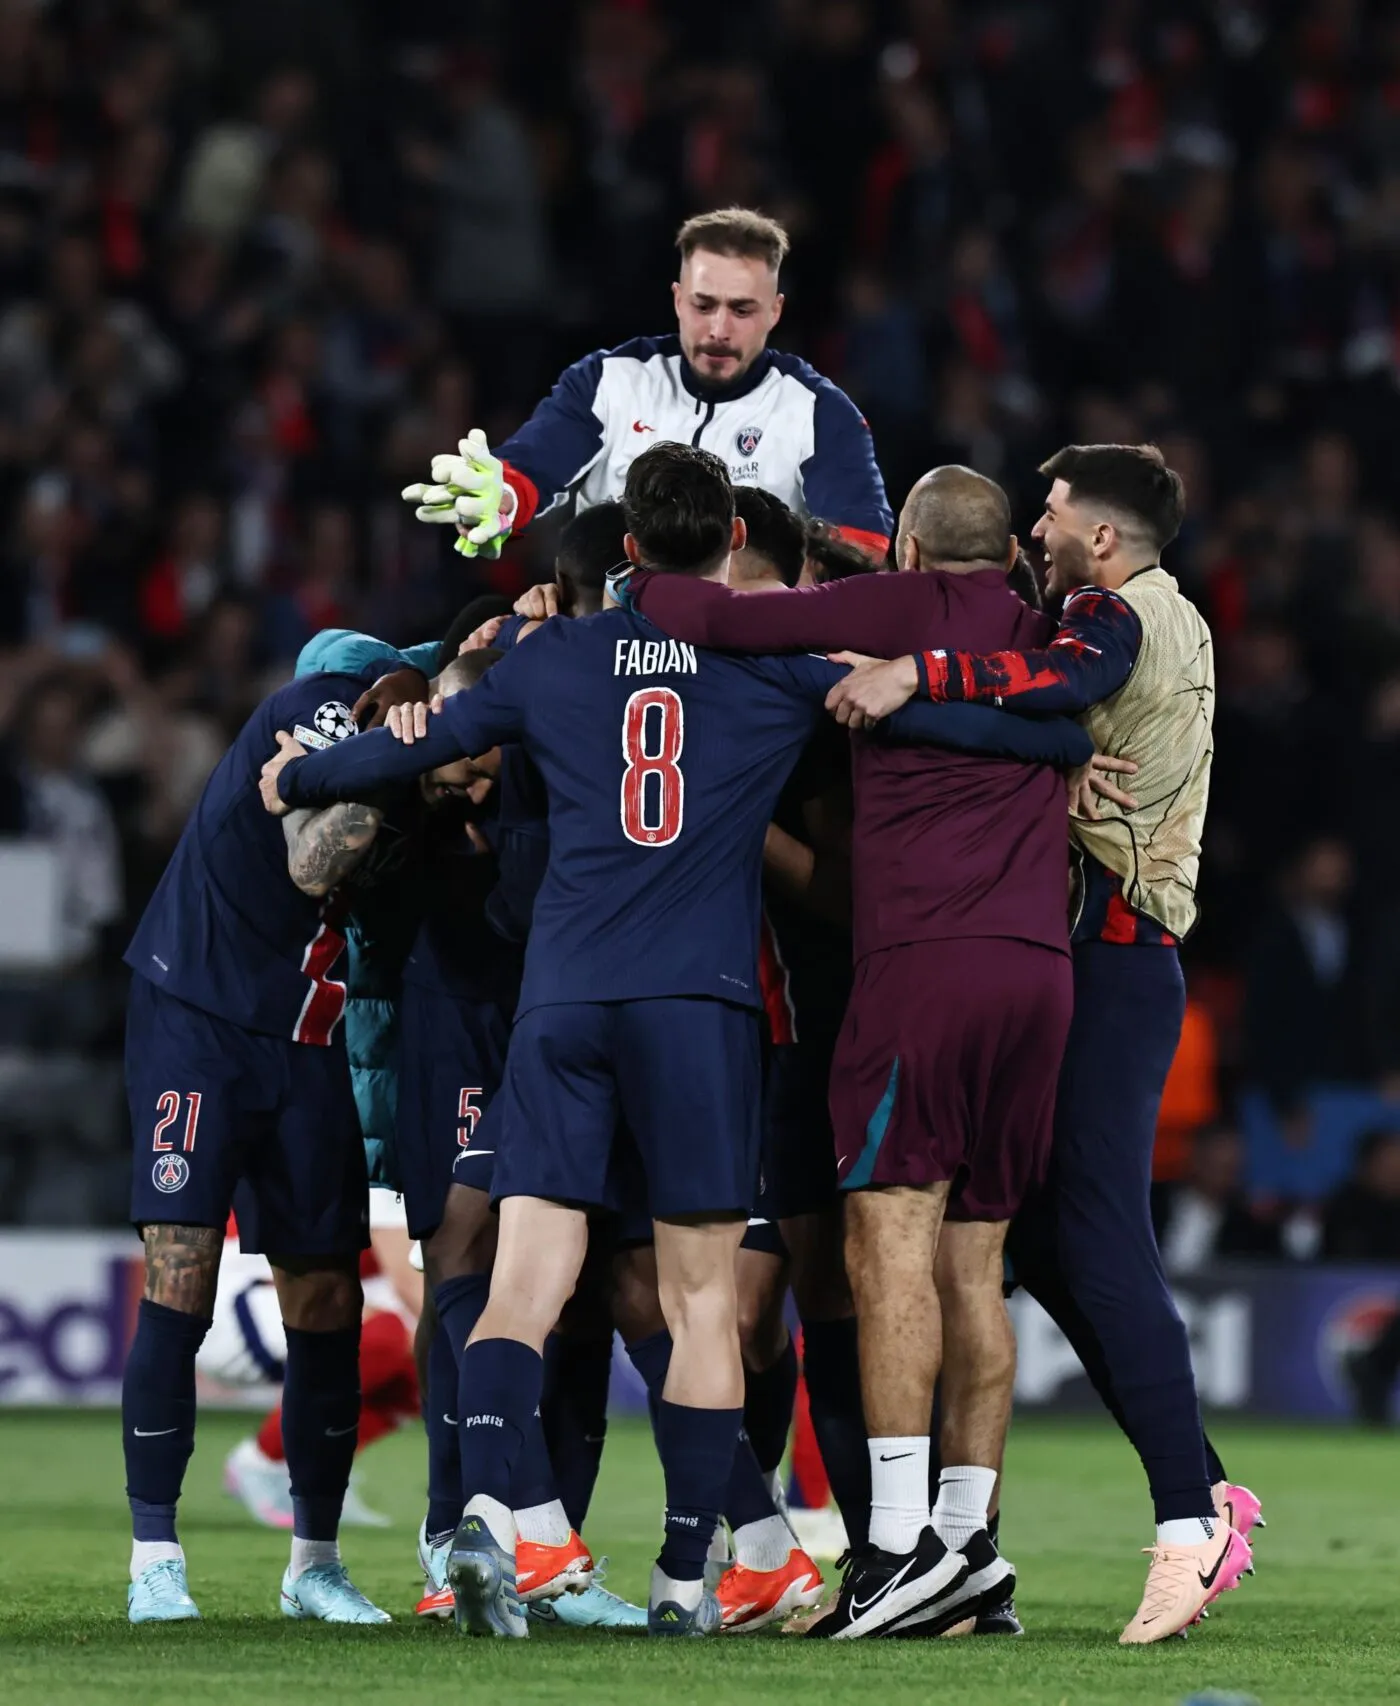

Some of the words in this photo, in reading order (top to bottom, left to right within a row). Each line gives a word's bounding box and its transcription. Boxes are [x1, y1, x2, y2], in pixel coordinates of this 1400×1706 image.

[614, 639, 698, 676] FABIAN
[620, 687, 684, 847] 8
[153, 1090, 202, 1152] 21
[457, 1087, 483, 1148] 5
[466, 1414, 504, 1428] PARIS
